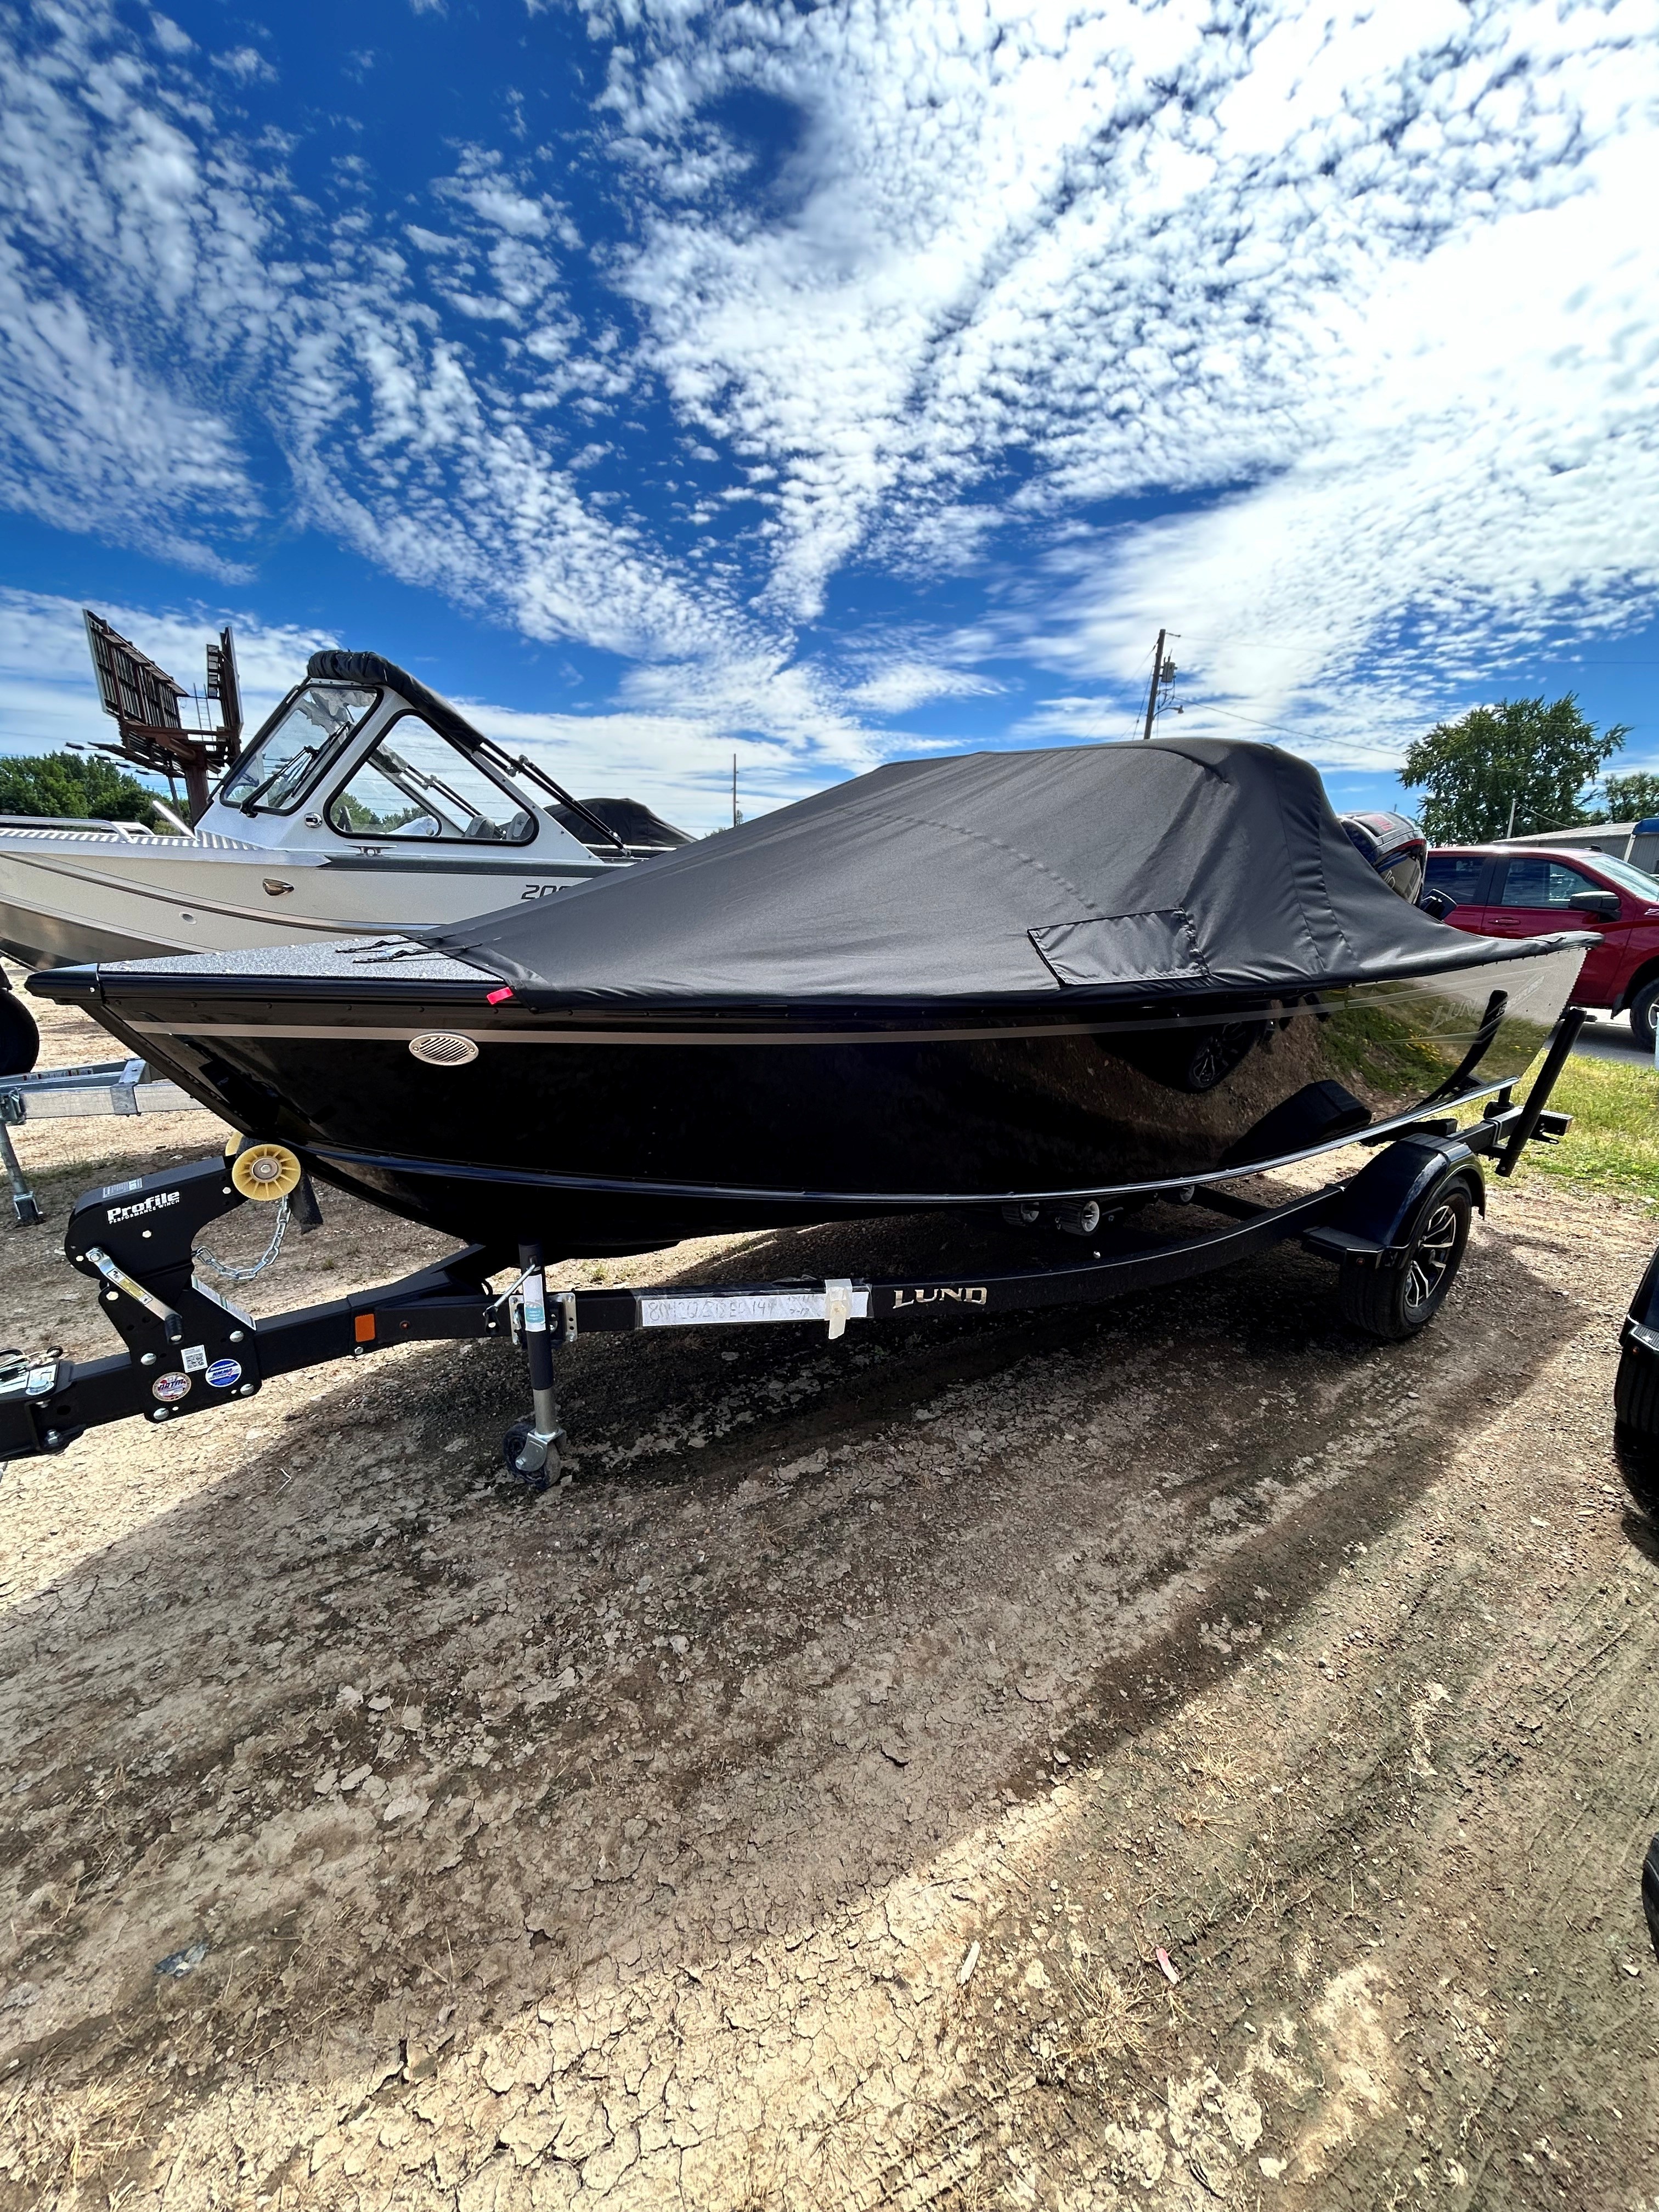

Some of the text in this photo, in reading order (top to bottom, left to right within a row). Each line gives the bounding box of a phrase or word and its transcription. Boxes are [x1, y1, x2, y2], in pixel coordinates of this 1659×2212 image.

[521, 884, 572, 900] 20
[107, 1192, 180, 1221] Profile
[109, 1198, 180, 1224] PERFORMANCE WINCH
[892, 1287, 988, 1309] LUND
